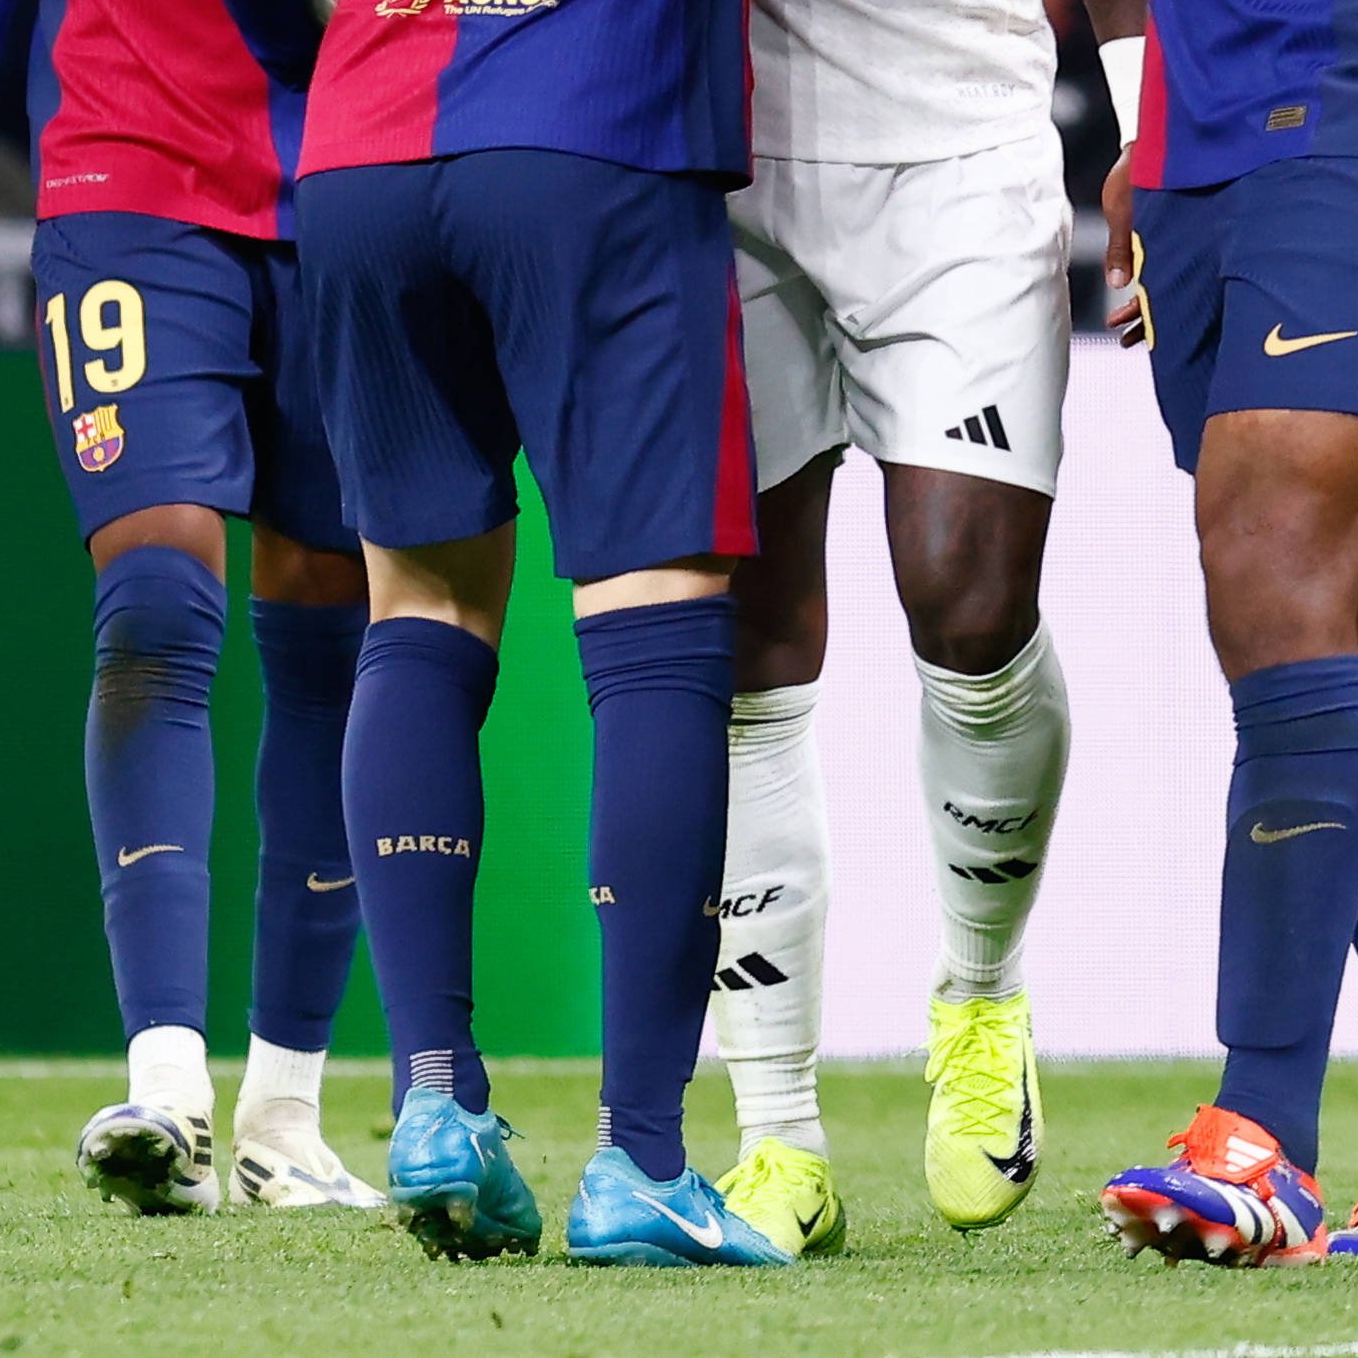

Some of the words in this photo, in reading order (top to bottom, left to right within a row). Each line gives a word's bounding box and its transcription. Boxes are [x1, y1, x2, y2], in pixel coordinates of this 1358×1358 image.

[444, 4, 463, 15] The
[464, 4, 482, 15] UN
[44, 278, 148, 415] 19
